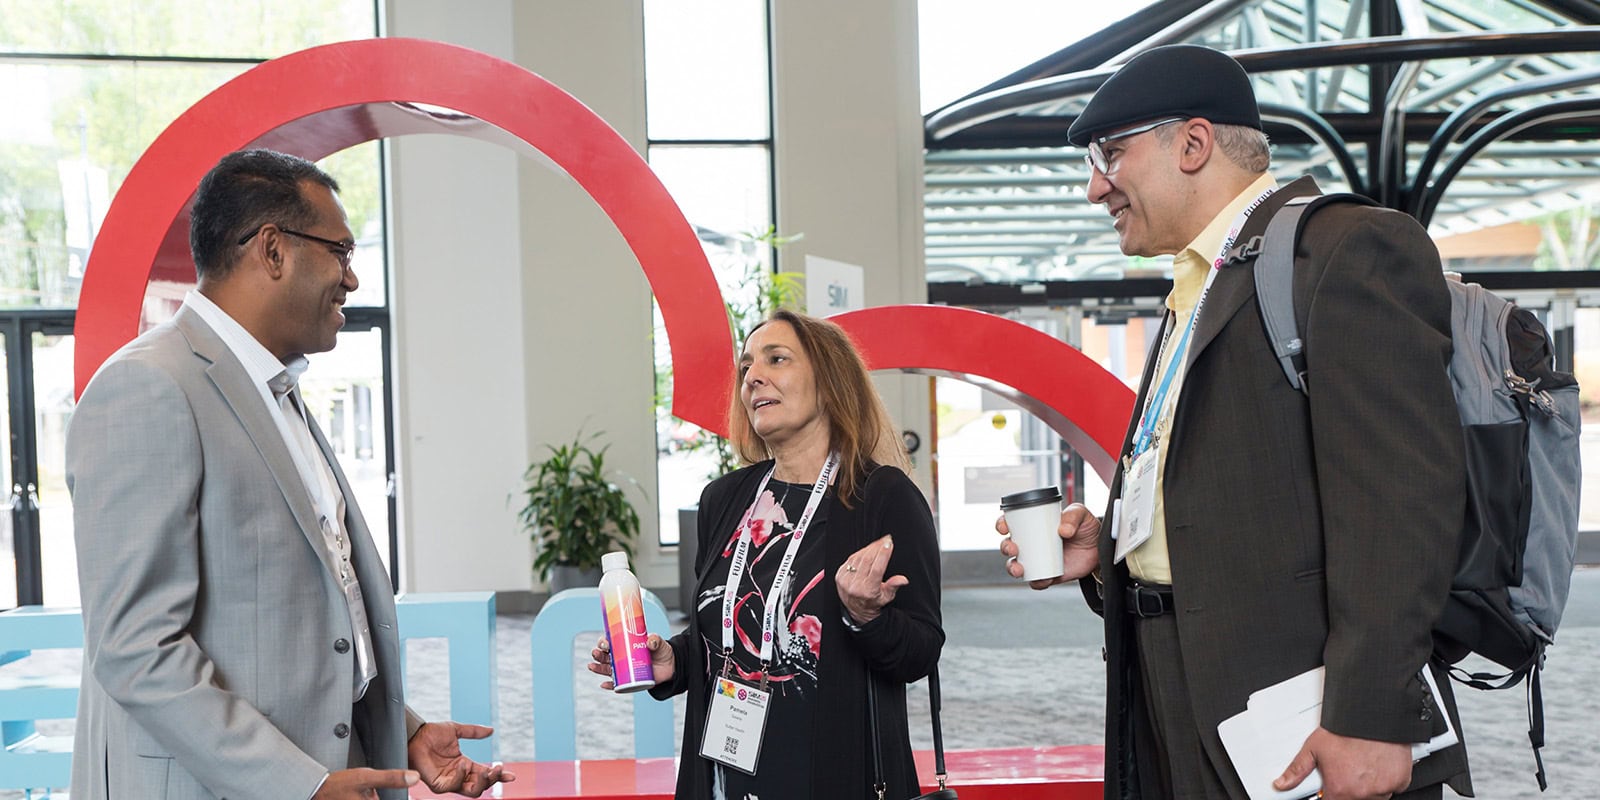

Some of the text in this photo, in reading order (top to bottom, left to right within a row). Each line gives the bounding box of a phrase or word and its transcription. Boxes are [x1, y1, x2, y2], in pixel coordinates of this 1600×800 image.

[815, 459, 835, 494] FUJIFILM
[732, 541, 747, 577] FUJIFILM
[774, 554, 793, 589] FUJIFILM
